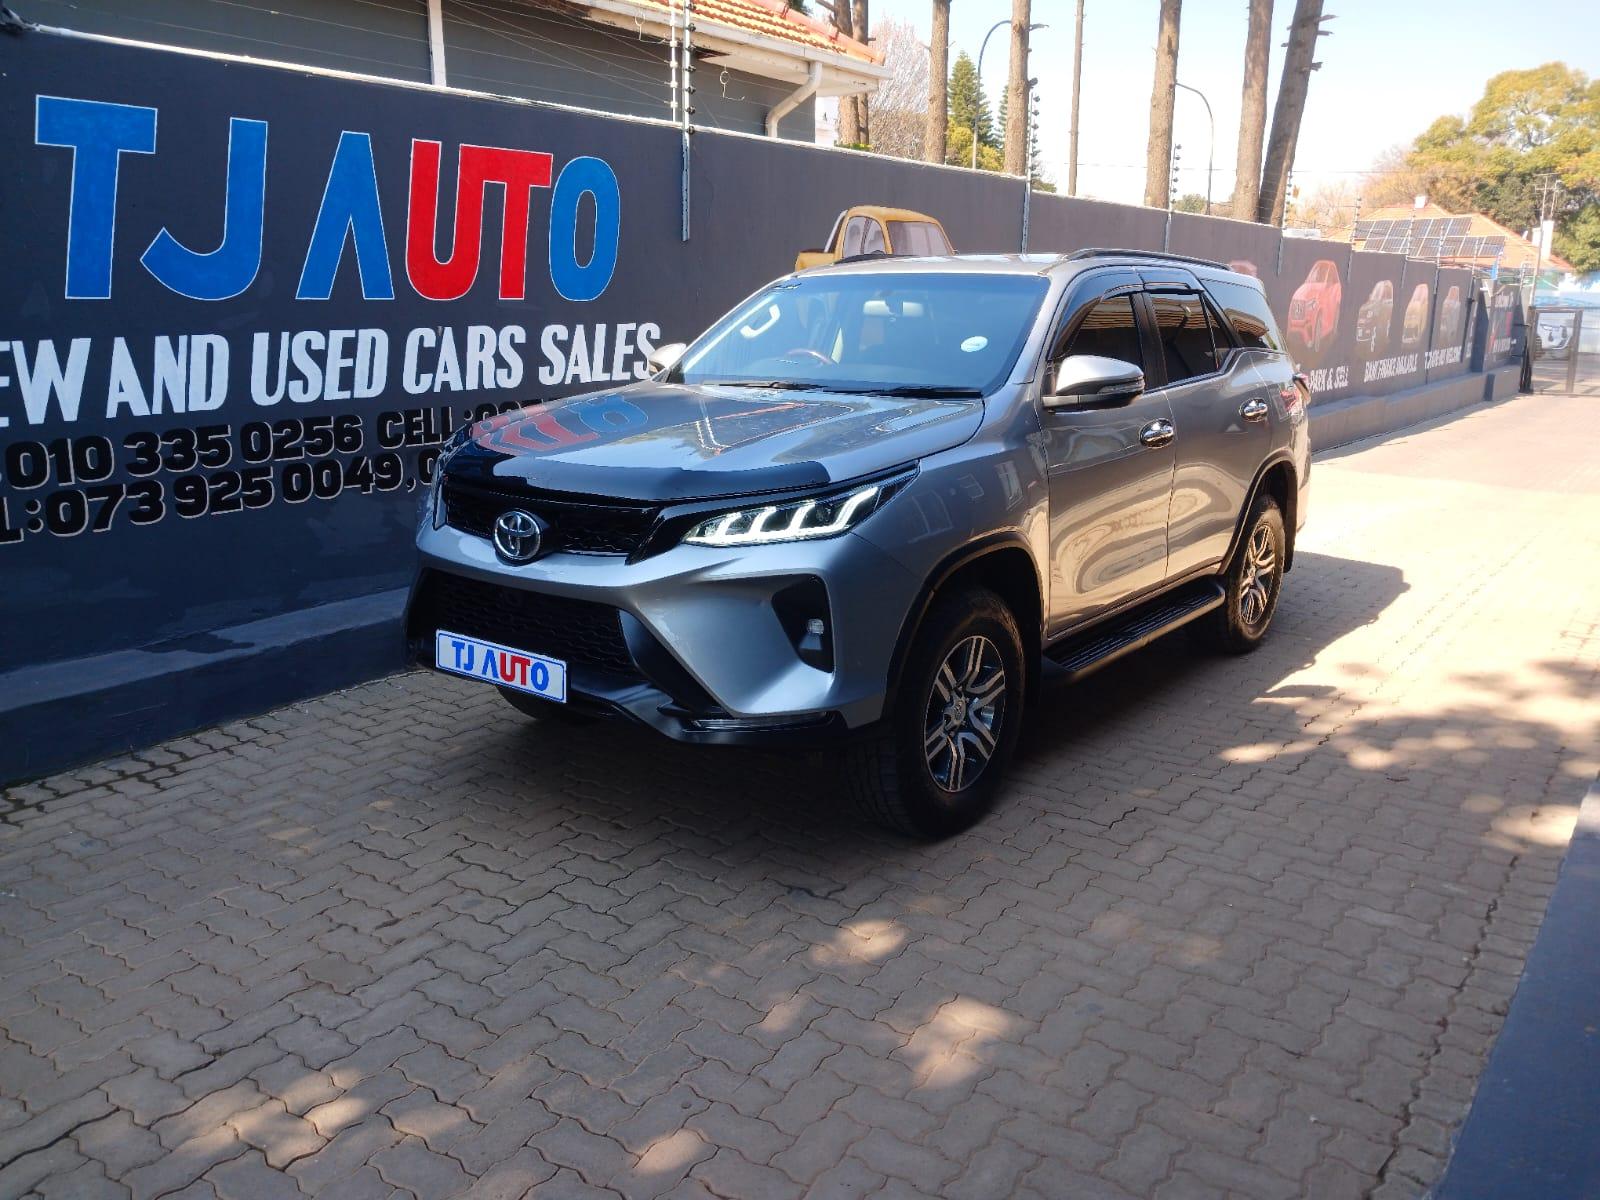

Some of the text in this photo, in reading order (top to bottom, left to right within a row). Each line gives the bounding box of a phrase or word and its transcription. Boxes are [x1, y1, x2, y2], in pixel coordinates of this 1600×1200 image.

[35, 94, 621, 301] TJ AUTO
[0, 321, 662, 427] W AND USED CARS SALES
[123, 424, 233, 478] 335
[240, 413, 363, 465] 0256
[173, 466, 275, 519] 925
[451, 640, 550, 692] TJ AUTO
